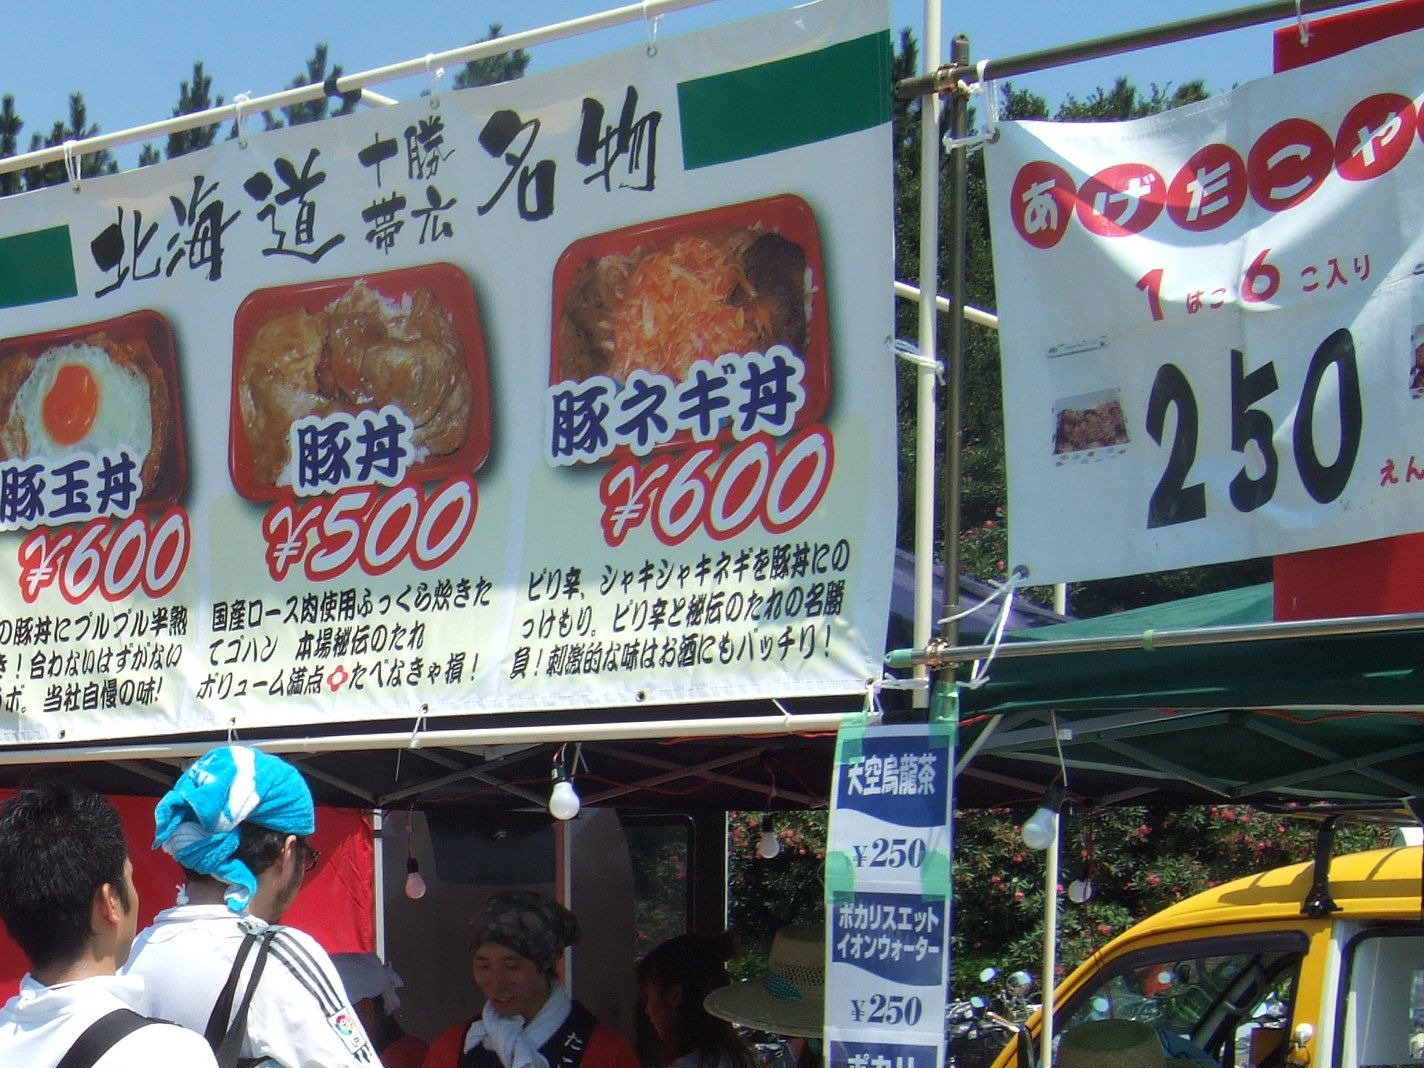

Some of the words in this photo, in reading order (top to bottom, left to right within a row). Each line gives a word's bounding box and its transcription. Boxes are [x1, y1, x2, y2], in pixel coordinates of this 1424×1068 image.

[90, 147, 345, 298] 北海道
[358, 115, 456, 189] 十勝
[477, 86, 663, 221] 名物
[362, 184, 459, 256] 帯広
[550, 355, 798, 459] 豚ネギ丼
[1146, 327, 1363, 531] 250
[296, 420, 408, 490] 豚丼
[600, 423, 835, 547] ¥600
[19, 507, 190, 603] ¥600
[263, 474, 478, 582] ¥500
[847, 752, 938, 797] 天空烏龍茶
[853, 838, 926, 868] ¥250
[837, 933, 940, 962] イオンウォーター
[838, 905, 939, 931] ポカリスエット
[850, 994, 922, 1027] ¥250
